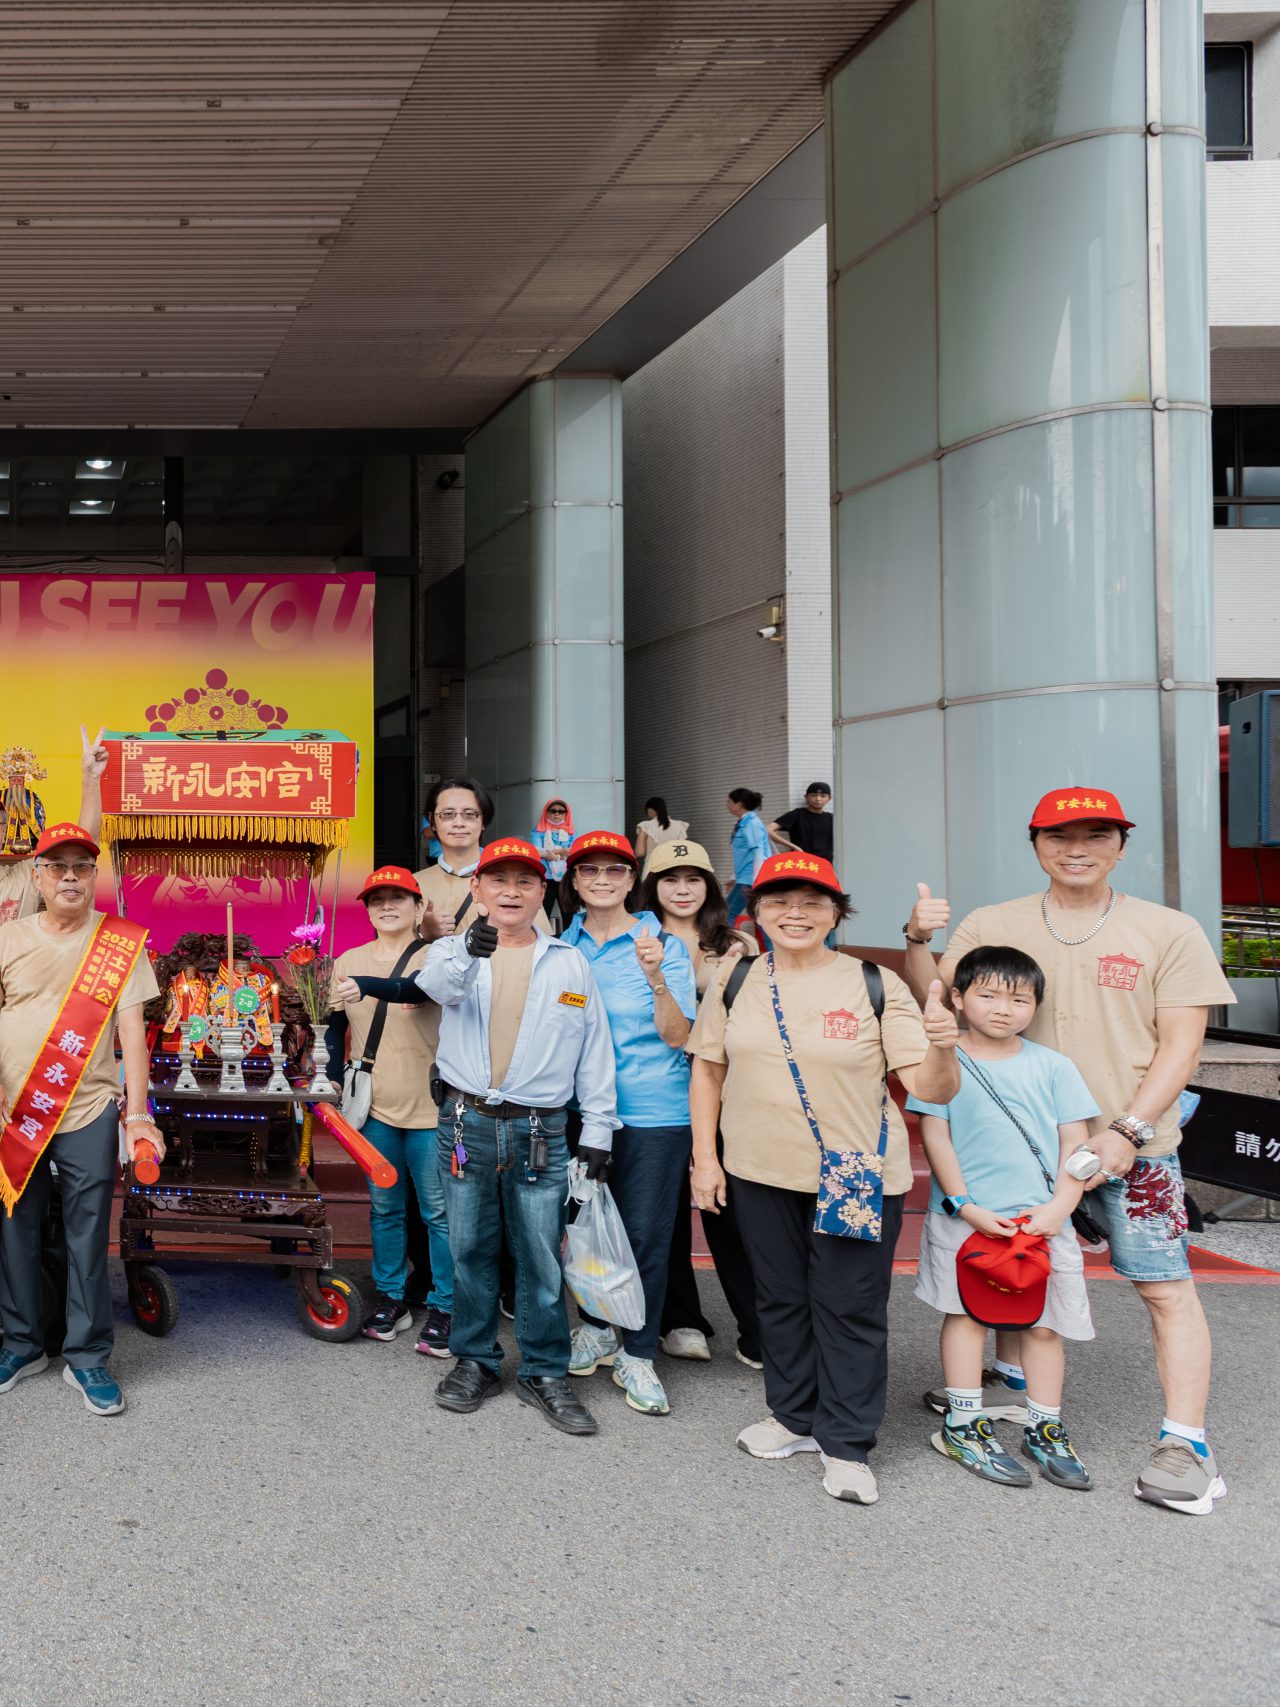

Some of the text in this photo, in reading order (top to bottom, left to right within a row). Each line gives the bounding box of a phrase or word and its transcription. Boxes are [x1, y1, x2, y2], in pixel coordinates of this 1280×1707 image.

[40, 579, 188, 648] SEE
[205, 581, 375, 650] YOU
[142, 756, 314, 802] 新永安宮
[101, 930, 136, 951] 2025
[95, 955, 127, 1005] 土地公
[18, 1028, 87, 1142] 新永安宮
